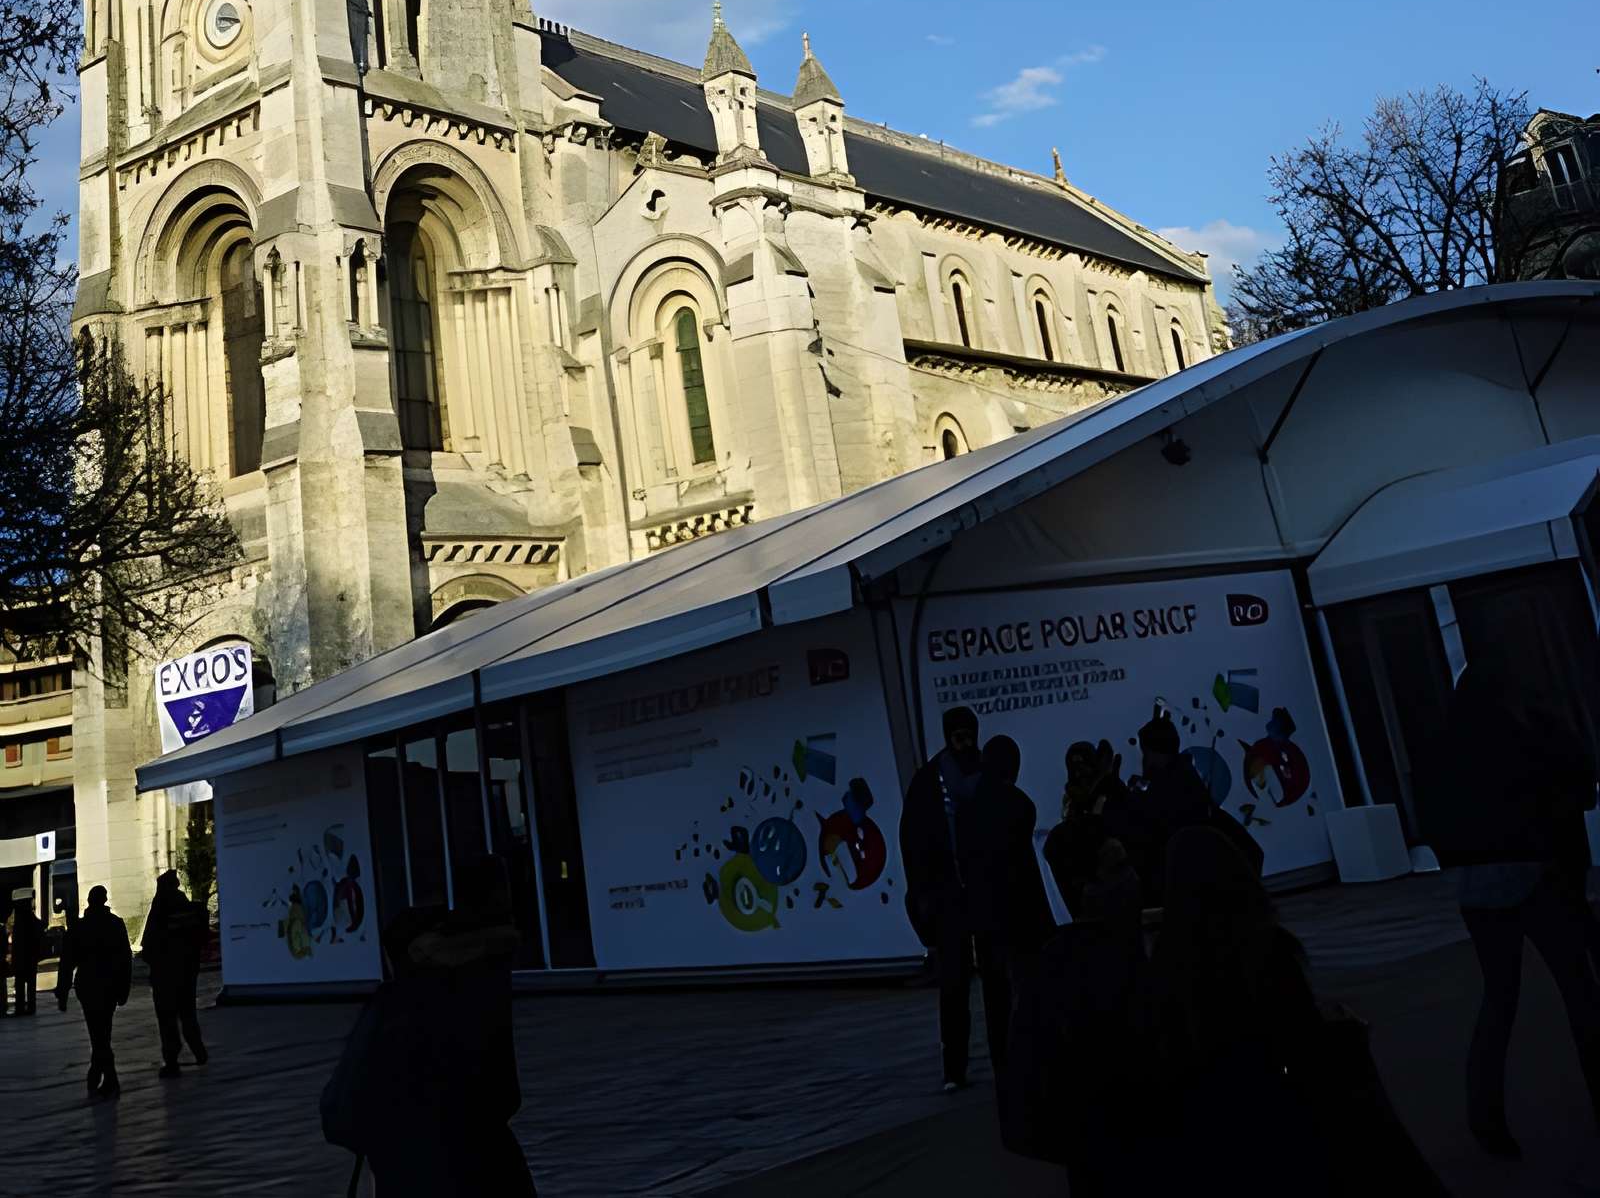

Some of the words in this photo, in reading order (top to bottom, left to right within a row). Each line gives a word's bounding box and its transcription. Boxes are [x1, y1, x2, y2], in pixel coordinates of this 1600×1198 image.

[928, 622, 1034, 661] ESPACE
[1040, 612, 1128, 648] POLAR
[1134, 604, 1197, 638] SNCF
[160, 648, 248, 695] EXPOS
